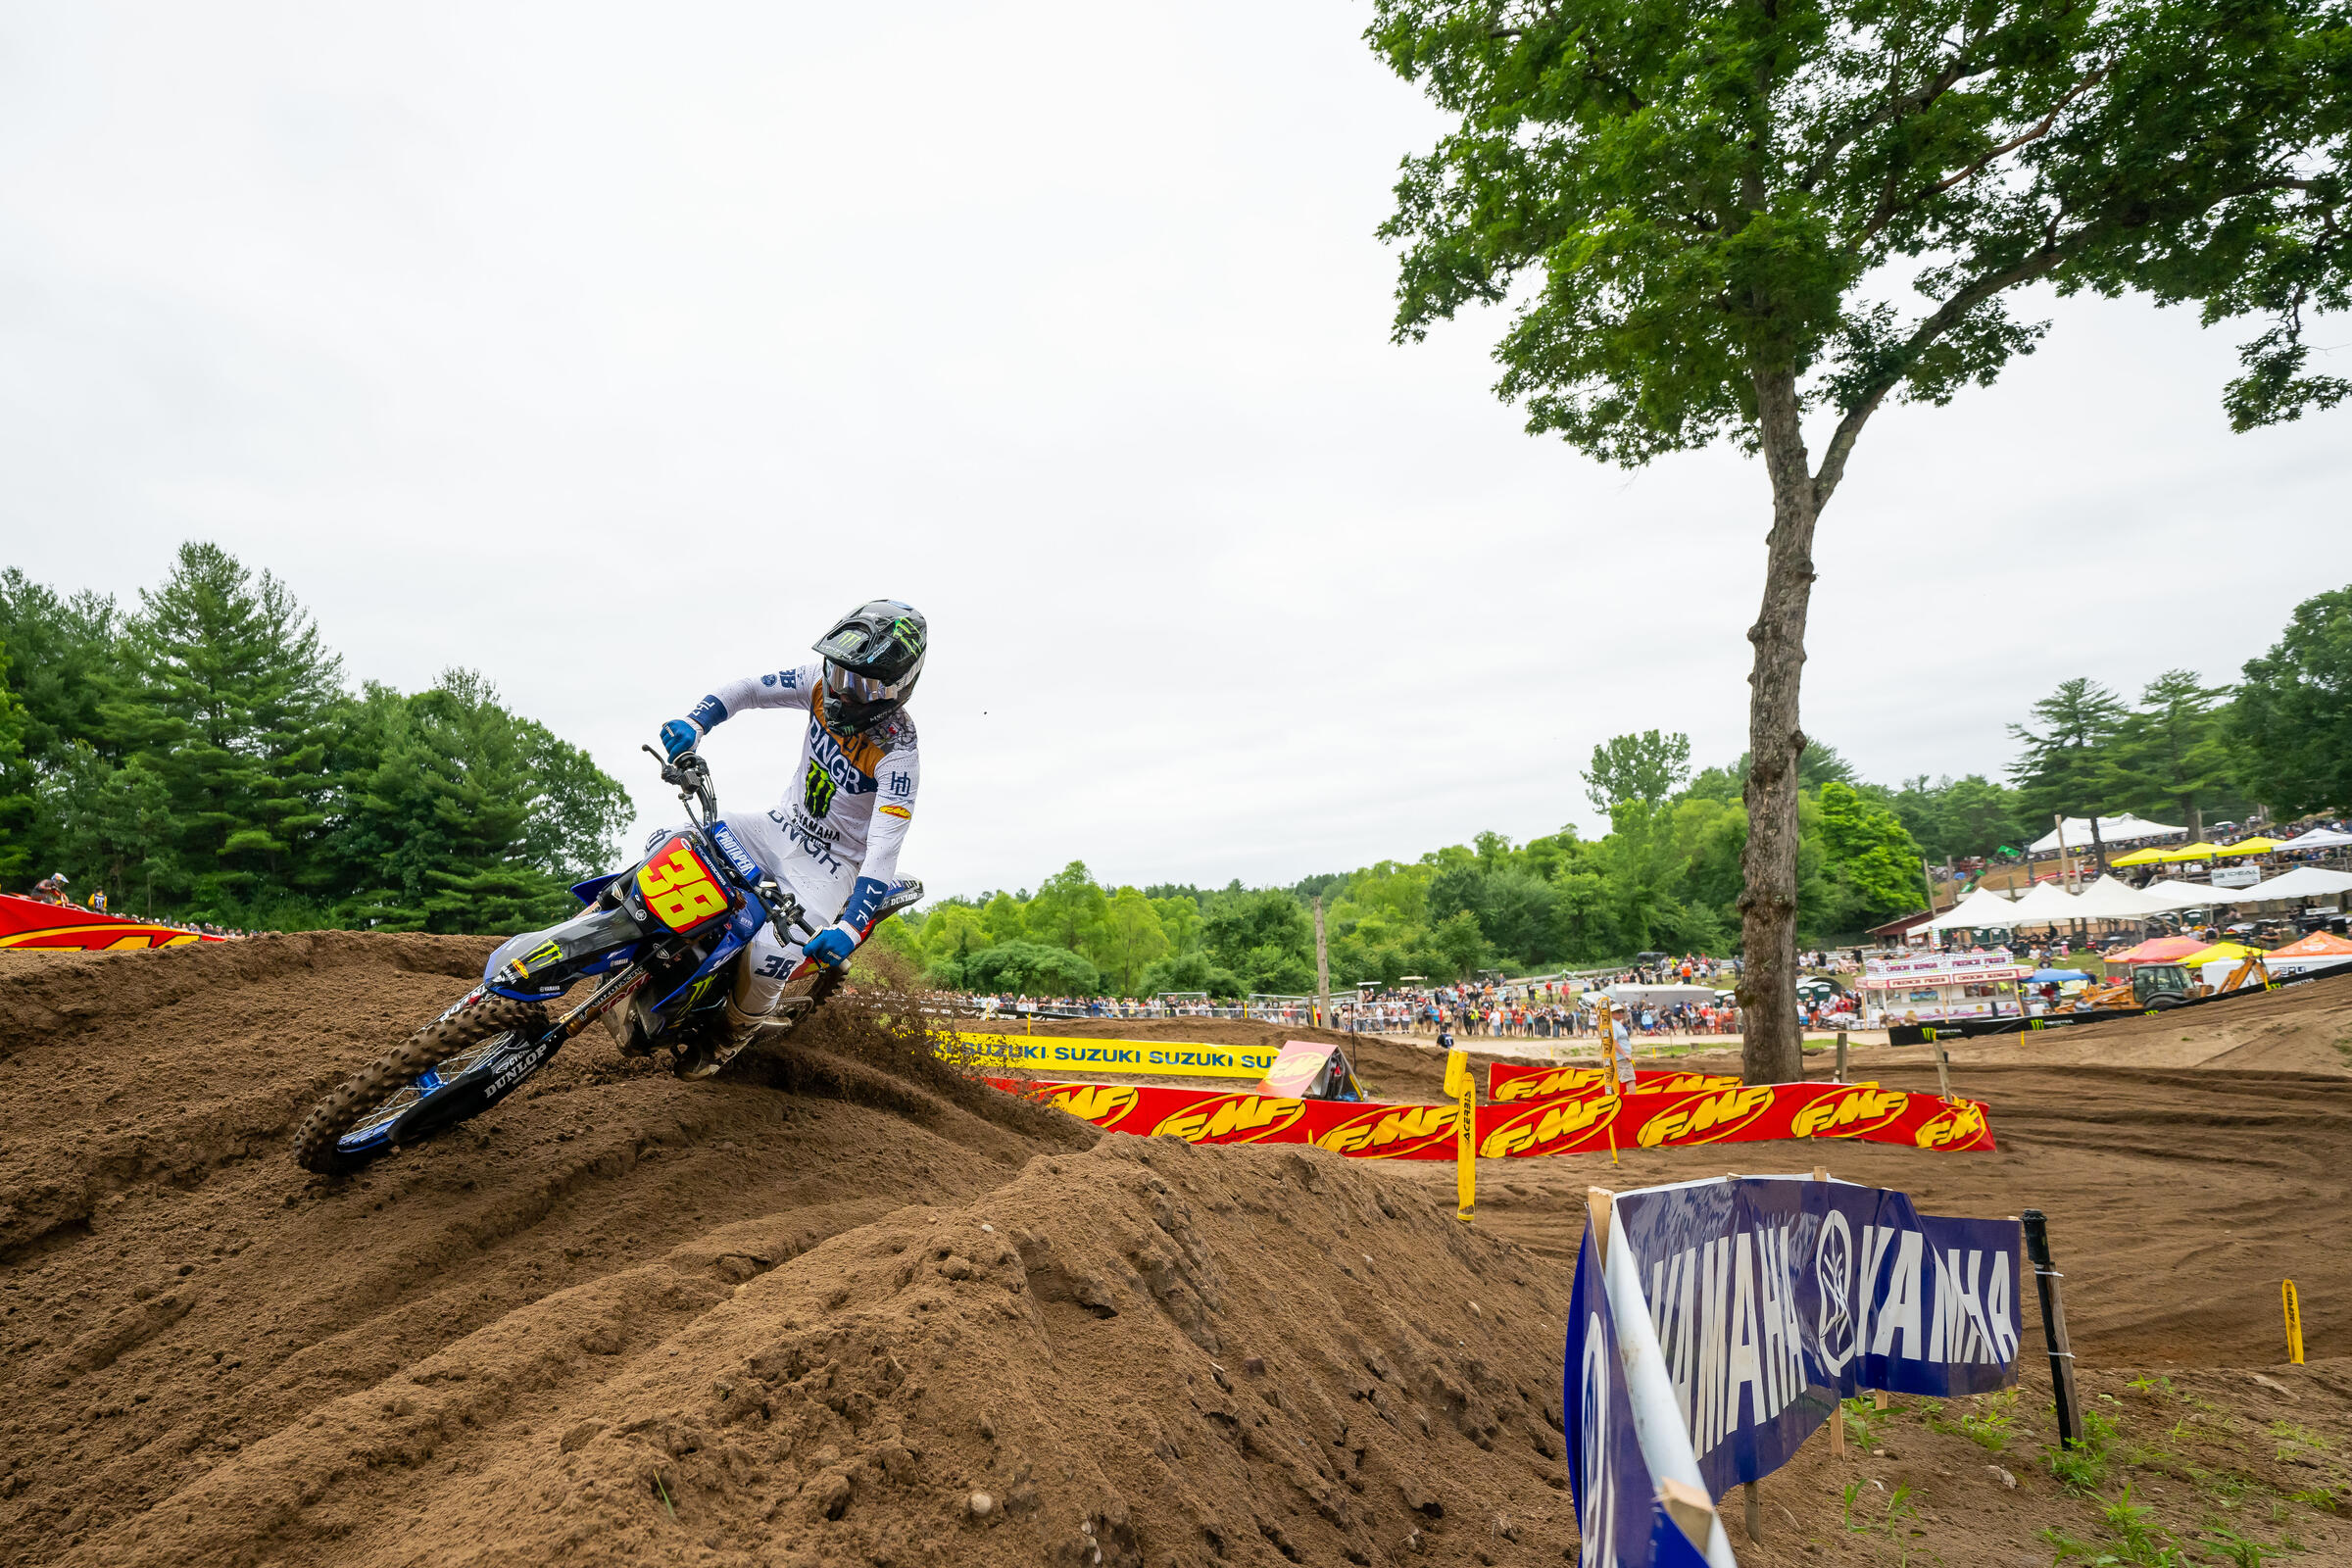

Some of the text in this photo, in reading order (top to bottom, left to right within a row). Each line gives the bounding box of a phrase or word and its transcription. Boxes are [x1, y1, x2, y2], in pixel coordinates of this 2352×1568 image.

[798, 812, 841, 842] YAMAHA
[719, 830, 754, 874] PROTAPER
[637, 849, 728, 928] 38
[890, 892, 918, 906] DUNLOP
[484, 1043, 547, 1099] DUNLOP
[1054, 1047, 1141, 1063] SUZUKI
[1148, 1051, 1234, 1067] SUZUKI
[1241, 1054, 1278, 1068] SU
[1497, 1068, 1606, 1102] FMF
[1047, 1085, 1136, 1121] MF
[1159, 1096, 1304, 1144] FMF
[1323, 1104, 1460, 1153] FMF
[1486, 1094, 1620, 1158] FMF
[1642, 1086, 1772, 1149] FMF
[1796, 1089, 1907, 1138] FMF
[1463, 1090, 1472, 1143] ACERBIS
